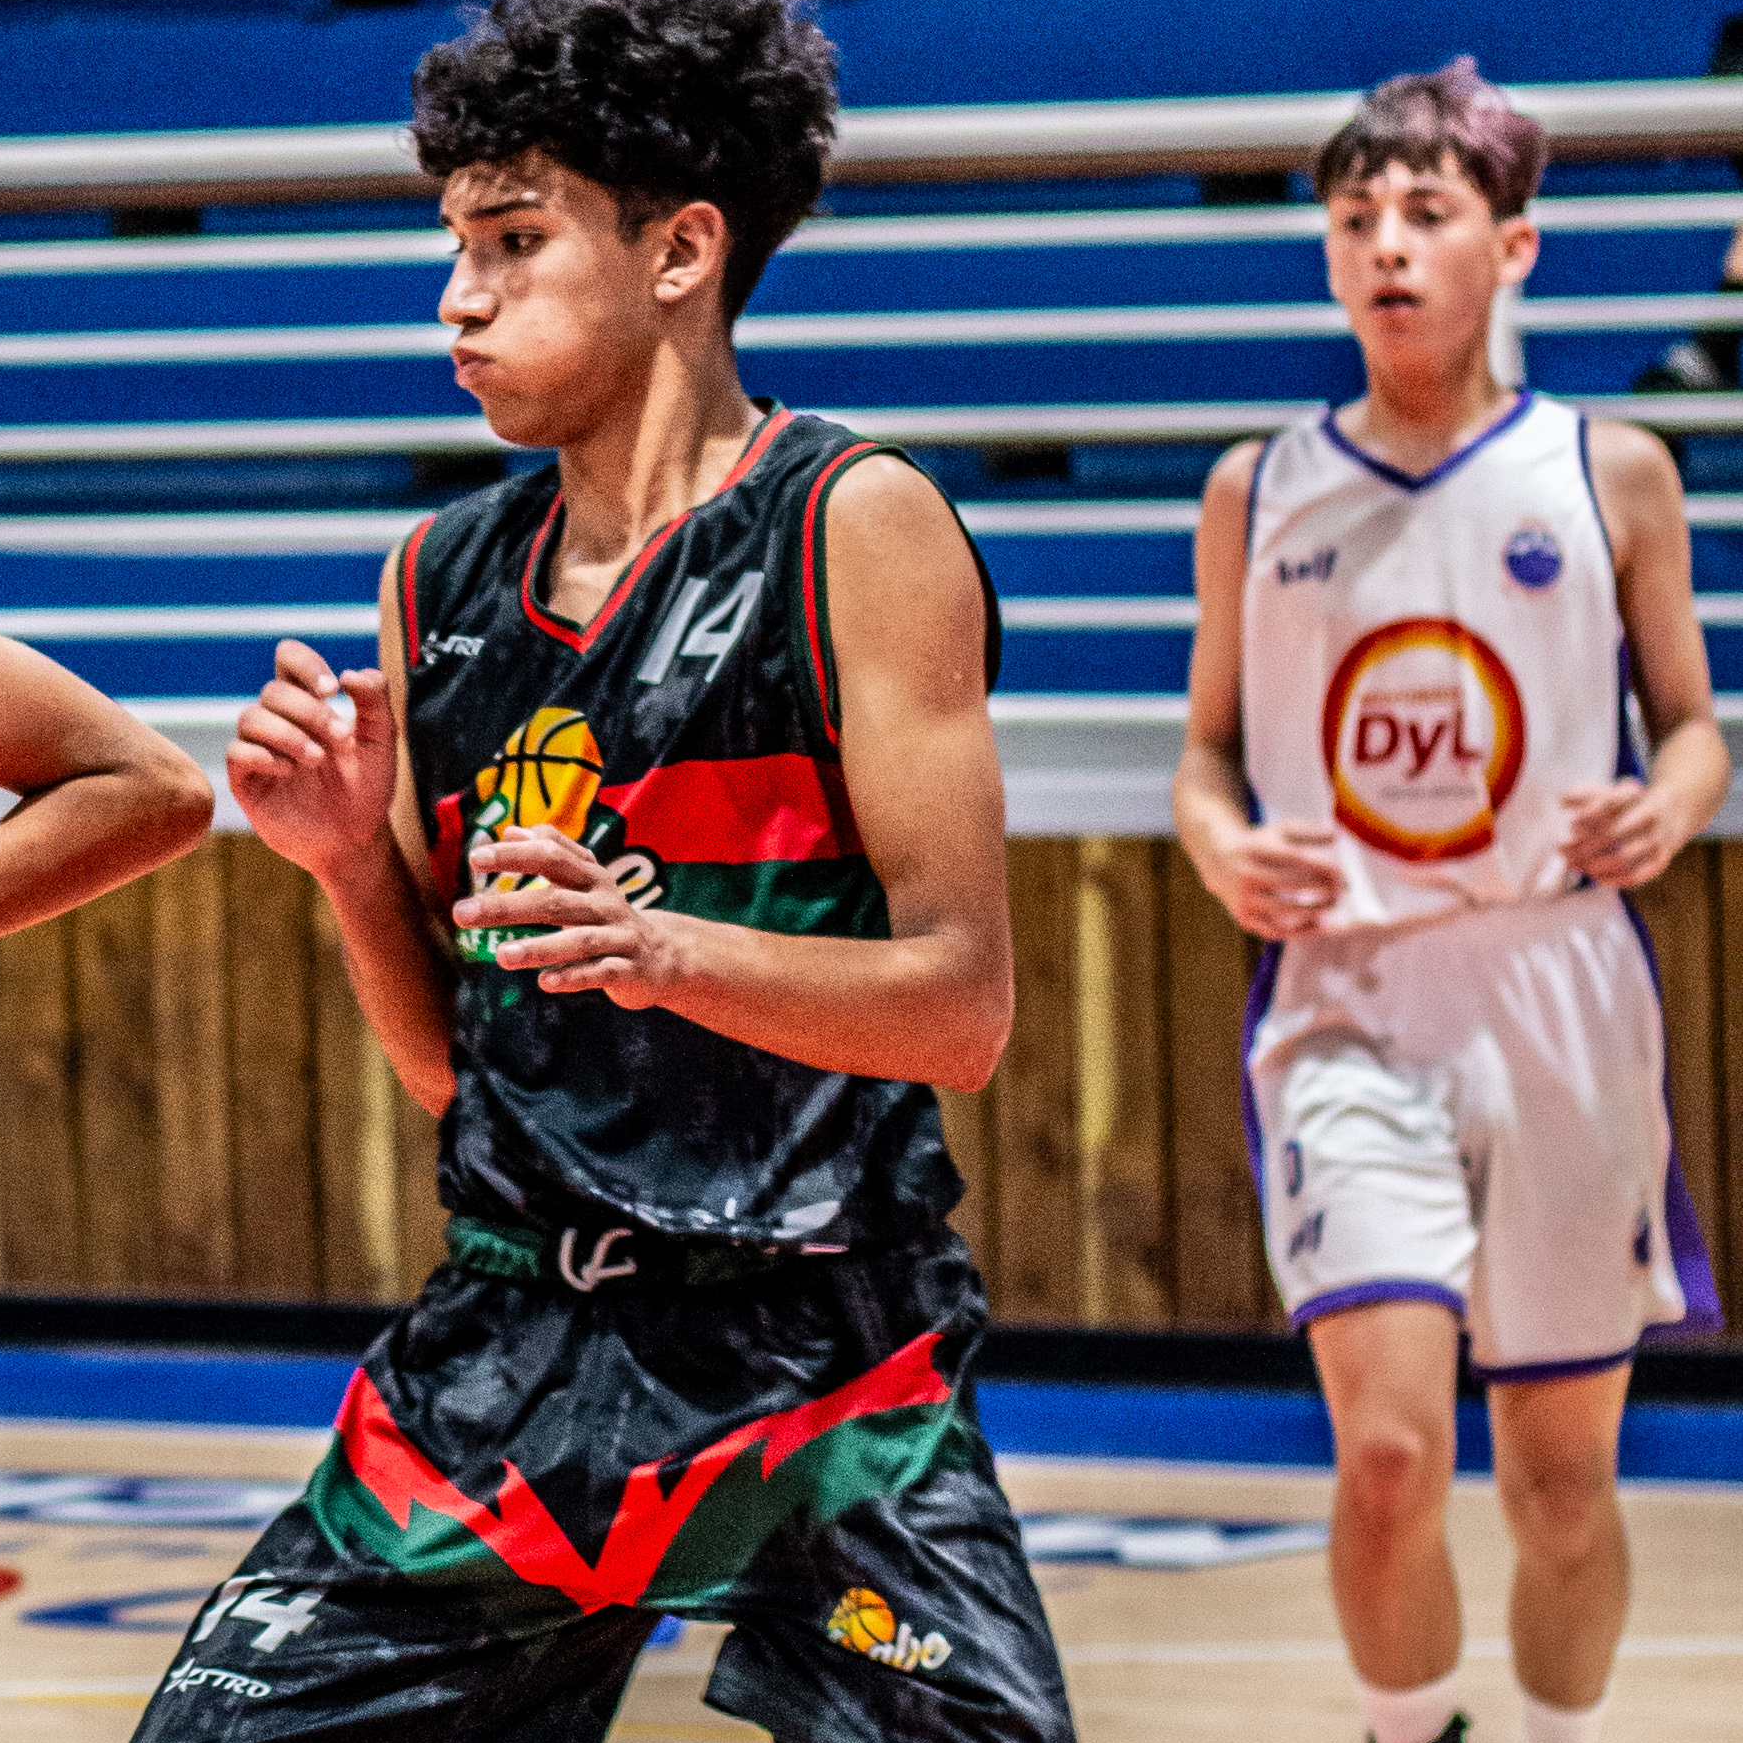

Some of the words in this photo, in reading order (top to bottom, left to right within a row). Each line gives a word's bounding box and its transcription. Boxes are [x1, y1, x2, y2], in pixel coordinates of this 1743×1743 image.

[637, 571, 765, 685] 14
[1356, 707, 1480, 781] DyL
[191, 1569, 323, 1654] 14
